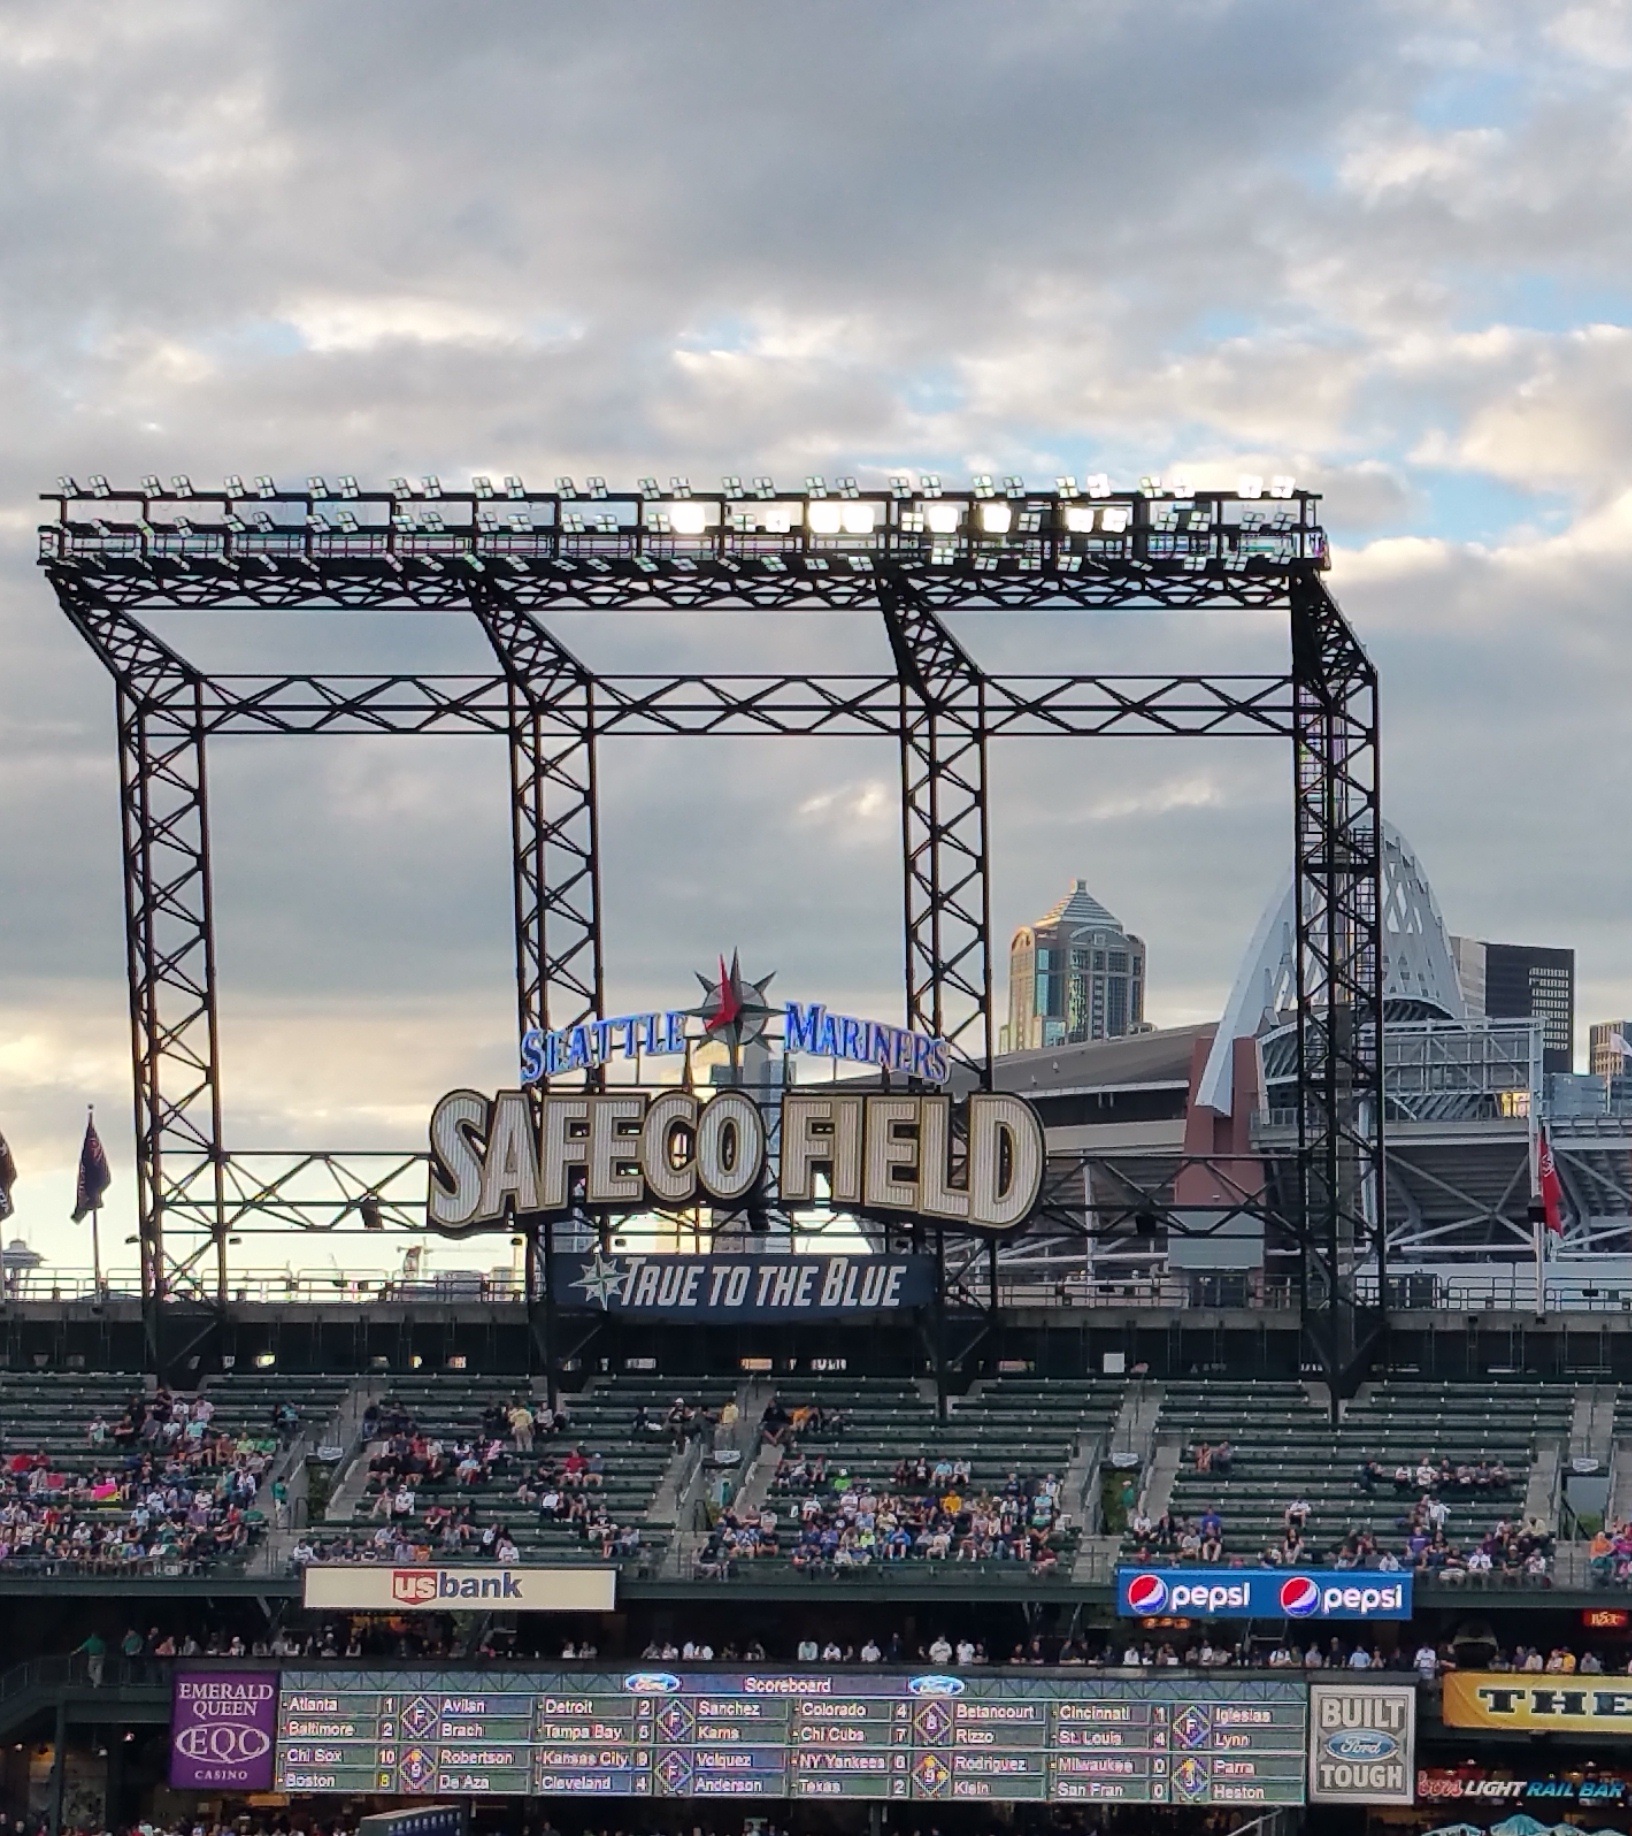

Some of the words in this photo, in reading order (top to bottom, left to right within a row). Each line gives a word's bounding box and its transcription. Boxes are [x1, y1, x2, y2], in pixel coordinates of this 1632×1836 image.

[520, 1010, 688, 1084] SEATTLE
[784, 1001, 951, 1084] MARINERS
[428, 1088, 768, 1233] SAFECO
[780, 1090, 1046, 1231] FIELD
[620, 1256, 705, 1306] TRUE
[709, 1266, 751, 1306] TO
[756, 1266, 819, 1306] THE
[819, 1256, 907, 1306] BLUE
[438, 1572, 523, 1598] bank
[1171, 1582, 1250, 1612] pepsi
[1322, 1584, 1402, 1614] pepsi
[180, 1683, 273, 1700] EMERALD
[745, 1677, 831, 1692] Scoreboard
[193, 1701, 257, 1719] QUEEN
[289, 1697, 338, 1711] Atlanta
[546, 1699, 593, 1713] Detroit
[699, 1701, 760, 1715] Sanchez
[802, 1702, 866, 1716] Colorado
[956, 1703, 1036, 1718] Betancourt
[1059, 1705, 1130, 1720] Cincinnati
[1215, 1708, 1271, 1724] Iglesias
[1321, 1697, 1405, 1728] BUILT
[288, 1722, 354, 1737] Baltimore
[441, 1723, 483, 1737] Brach
[544, 1724, 590, 1739] Tampa
[592, 1724, 622, 1740] Bay
[955, 1729, 994, 1743] Rizzo
[189, 1727, 263, 1764] EQC
[1083, 1731, 1122, 1746] Louis
[1215, 1733, 1250, 1748] Lynn
[1341, 1736, 1383, 1754] Ford
[286, 1749, 310, 1762] Chi
[314, 1749, 342, 1762] Sox
[441, 1750, 514, 1765] Robertson
[543, 1751, 597, 1765] Kansas
[600, 1751, 629, 1767] City
[825, 1755, 885, 1769] Yankees
[954, 1755, 1028, 1773] Rodriguez
[1059, 1757, 1134, 1772] Milwaukee
[1214, 1760, 1255, 1774] Parra
[195, 1770, 248, 1780] CASINO
[285, 1773, 335, 1787] Boston
[463, 1775, 490, 1789] Aza
[542, 1775, 611, 1790] Cleveland
[1320, 1764, 1403, 1789] TOUGH
[696, 1777, 762, 1791] Anderson
[800, 1779, 841, 1793] Texas
[1058, 1782, 1086, 1796] San
[1090, 1783, 1123, 1797] Fran
[1464, 1780, 1527, 1797] LIGHT
[1527, 1781, 1574, 1797] RAIL
[1579, 1781, 1626, 1798] BAR
[1214, 1785, 1264, 1799] Heston
